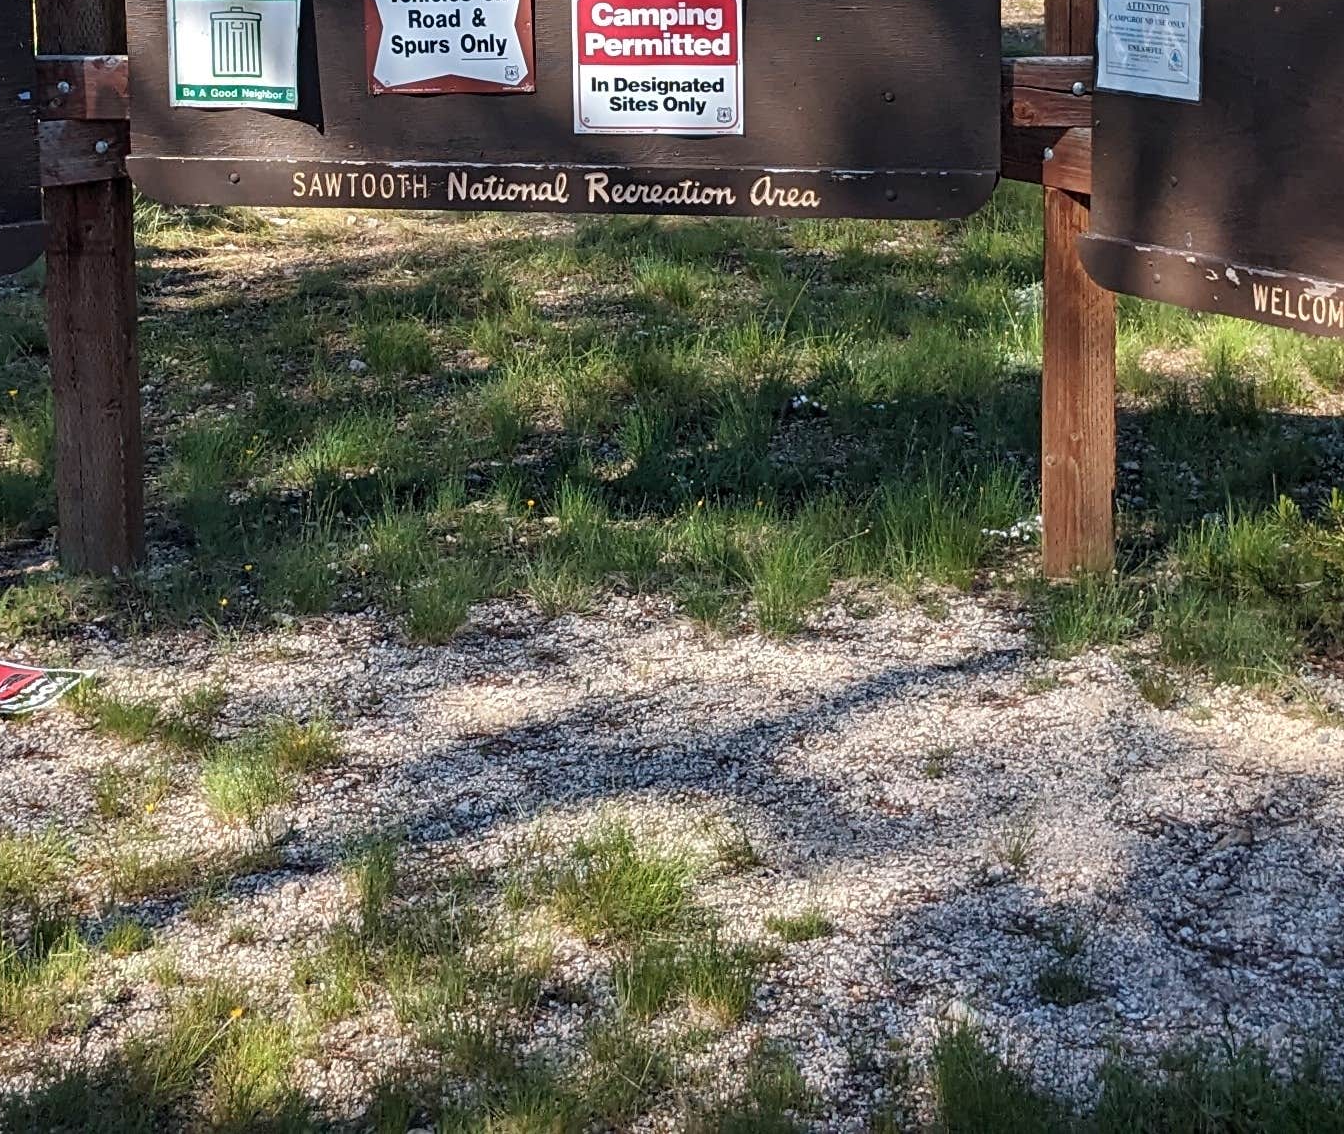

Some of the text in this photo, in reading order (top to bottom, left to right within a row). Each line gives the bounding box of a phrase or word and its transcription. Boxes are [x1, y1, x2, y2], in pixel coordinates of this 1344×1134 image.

[408, 7, 487, 29] Road &
[591, 1, 723, 31] Camping
[1127, 2, 1170, 13] ATTENTION
[391, 33, 508, 58] Spurs Only
[584, 32, 730, 57] Permitted
[182, 88, 283, 101] Be A Good Neighbor
[591, 76, 725, 95] In Designated
[609, 96, 707, 115] Sites Only
[292, 170, 821, 208] SAWTOOTH National Recreation Area
